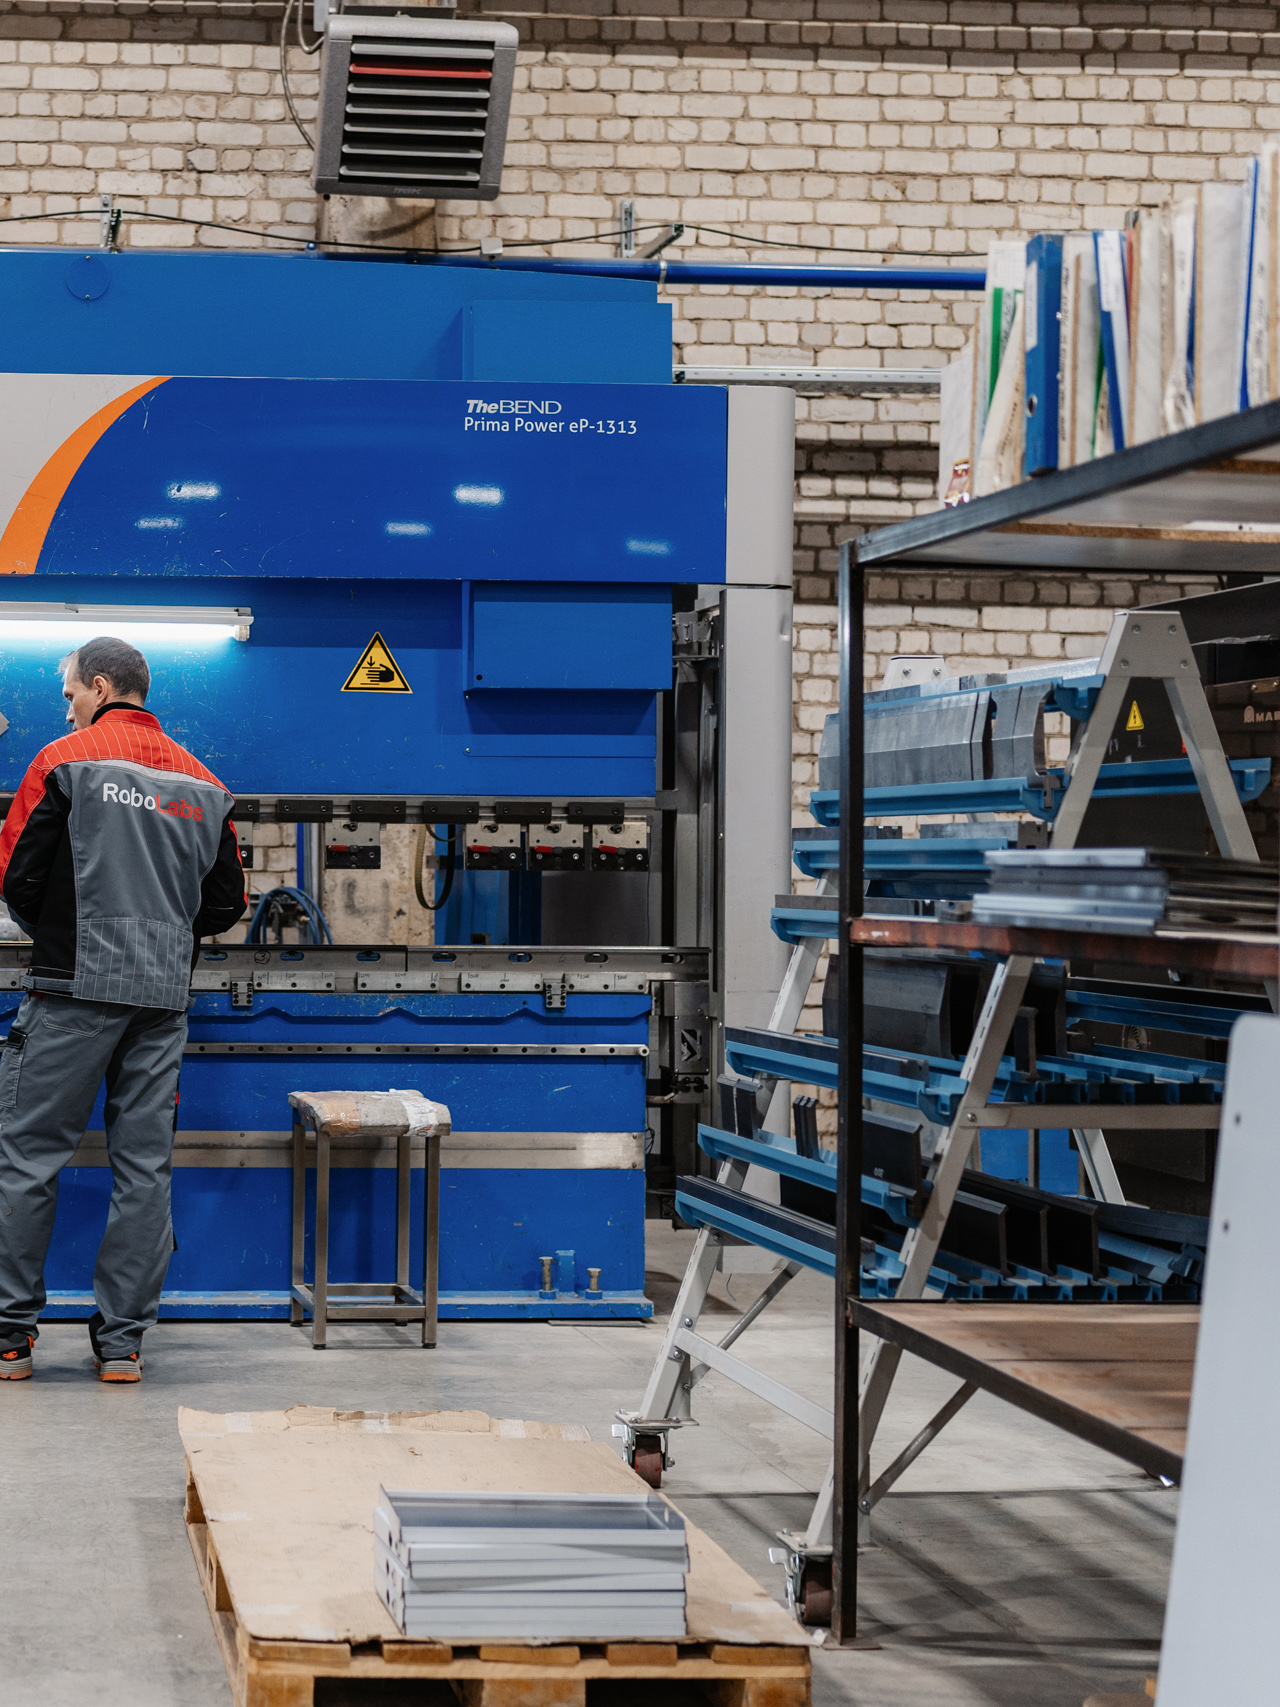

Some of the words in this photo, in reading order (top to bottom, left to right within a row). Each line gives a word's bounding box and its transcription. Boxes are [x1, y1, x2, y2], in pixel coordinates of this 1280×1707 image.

[464, 417, 510, 432] Prima
[514, 417, 565, 433] Power
[569, 418, 638, 435] eP-1313
[102, 782, 204, 822] RoboLabs
